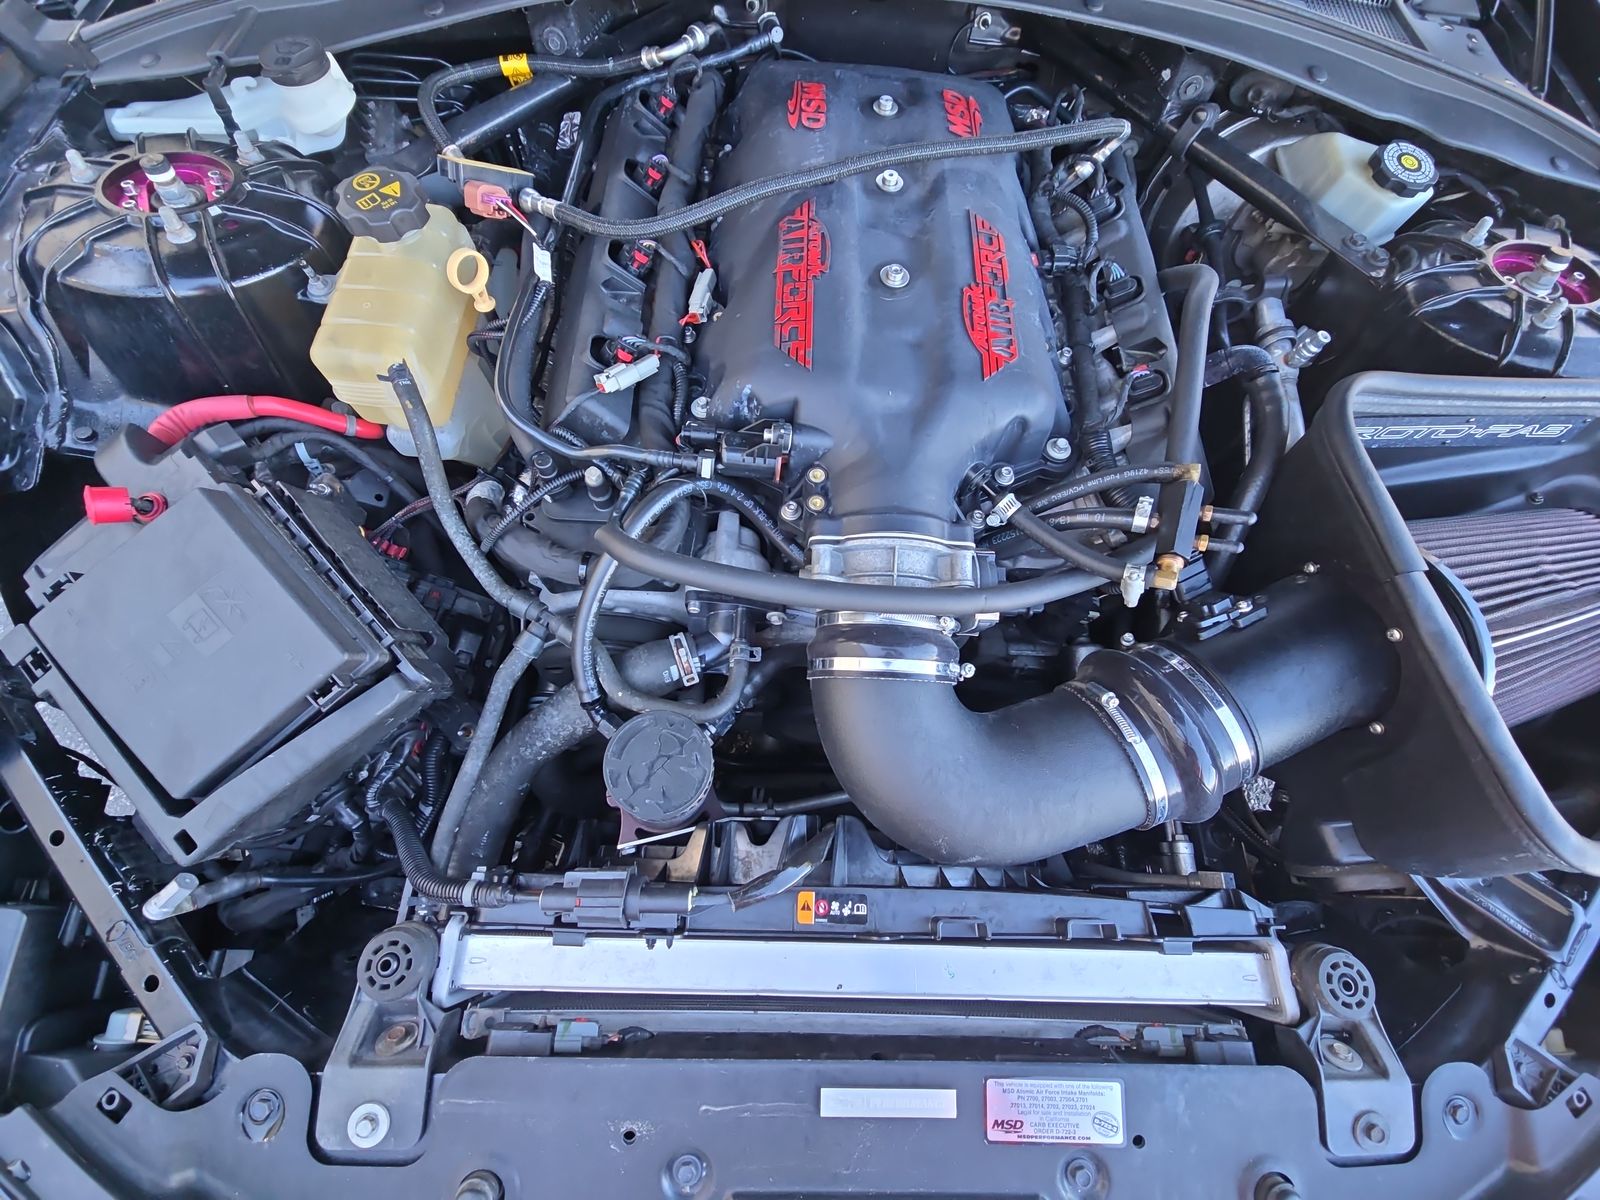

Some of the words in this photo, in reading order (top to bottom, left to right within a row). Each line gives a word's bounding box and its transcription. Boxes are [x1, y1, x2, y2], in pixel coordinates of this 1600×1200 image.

[800, 82, 828, 130] MSD
[942, 88, 977, 138] MSD
[1123, 468, 1149, 478] 4219G
[991, 1119, 1025, 1130] MSD
